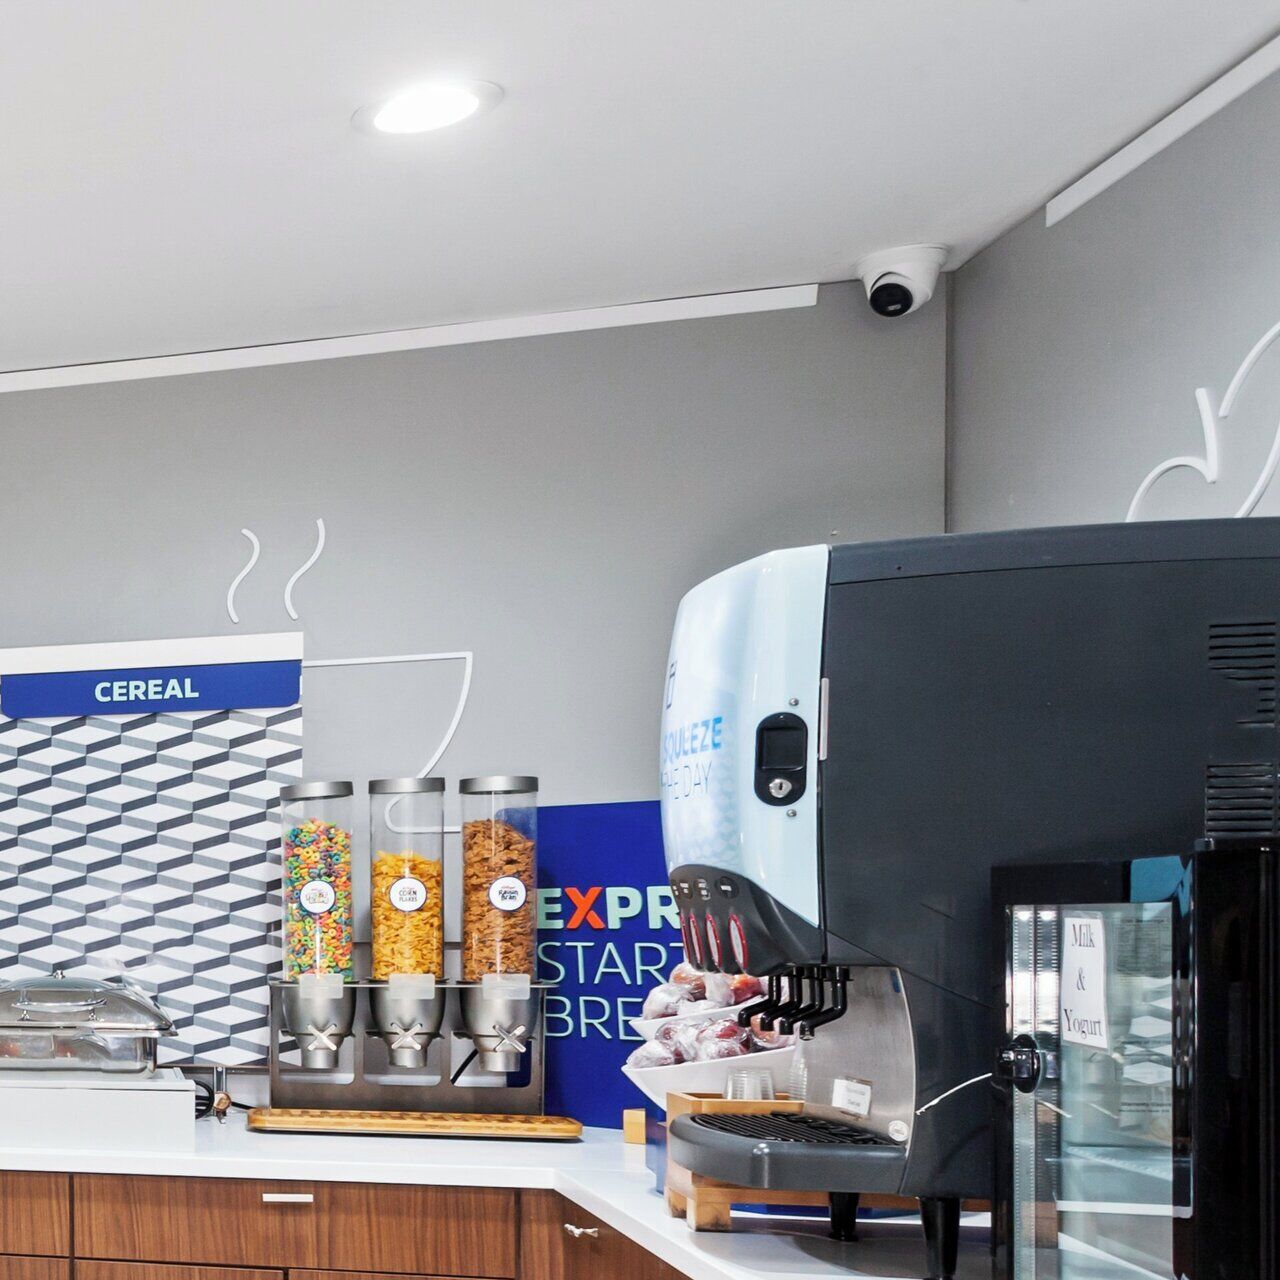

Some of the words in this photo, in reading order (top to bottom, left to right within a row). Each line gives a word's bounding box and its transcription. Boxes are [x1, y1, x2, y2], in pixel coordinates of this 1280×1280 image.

[94, 678, 199, 702] CEREAL
[683, 760, 712, 799] DAY
[1071, 923, 1096, 948] Milk
[1076, 967, 1086, 991] &
[1063, 1008, 1103, 1039] Yogurt
